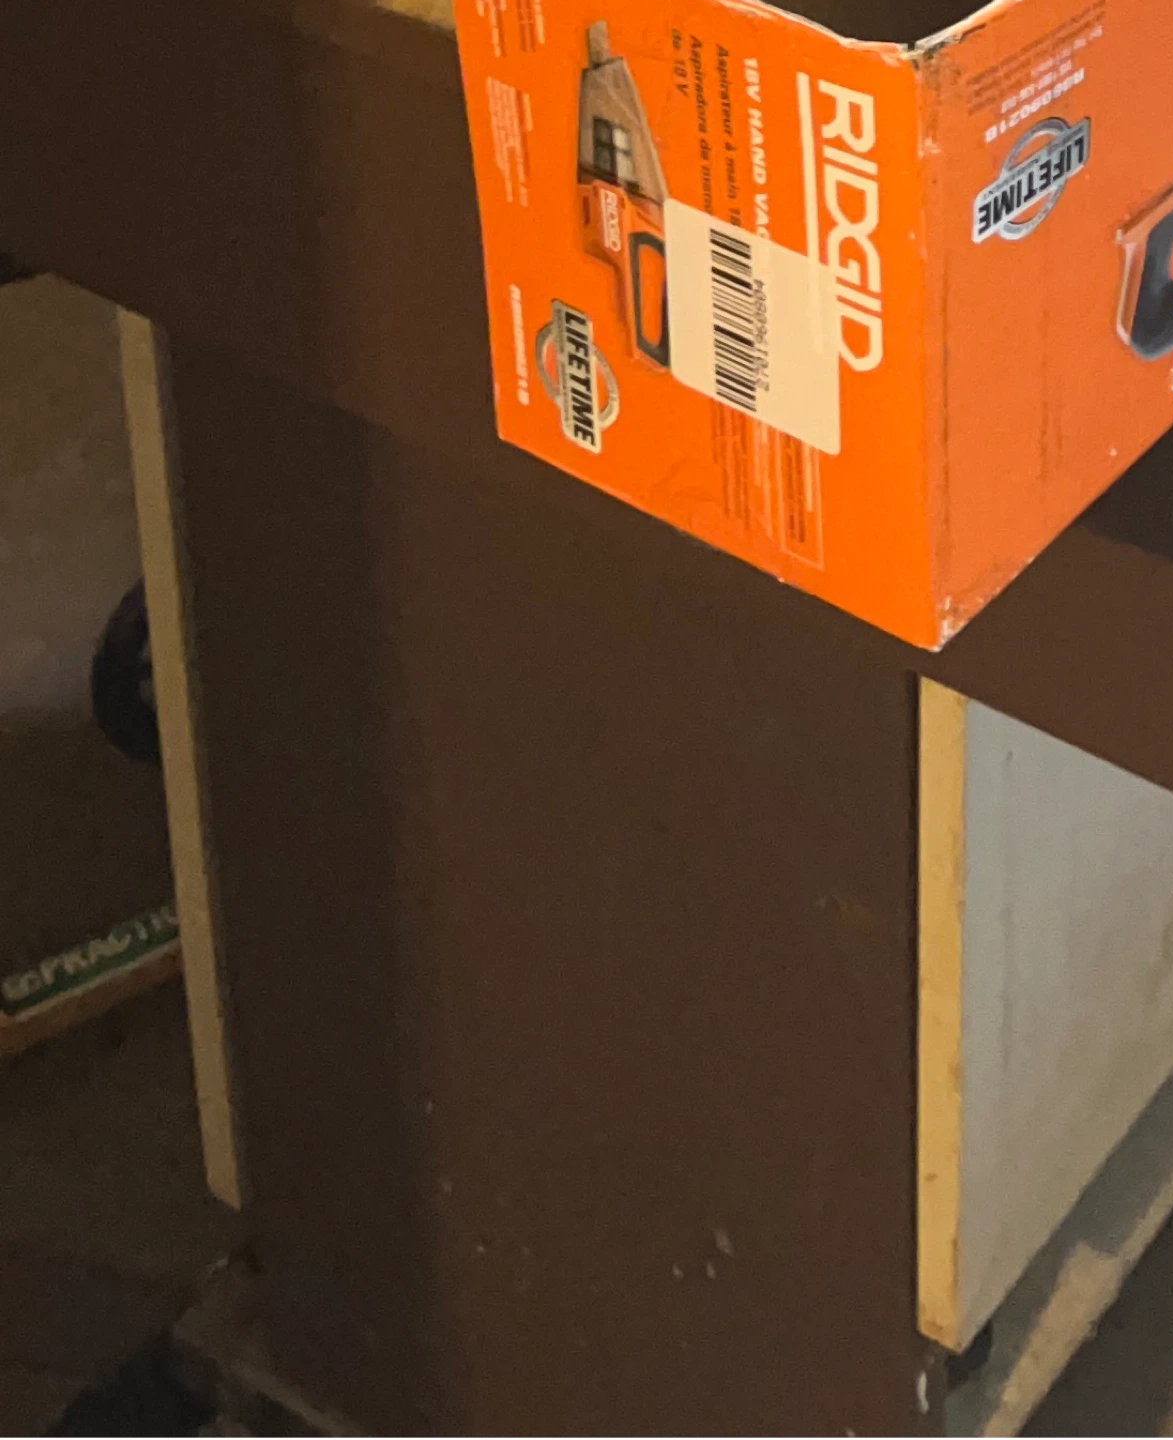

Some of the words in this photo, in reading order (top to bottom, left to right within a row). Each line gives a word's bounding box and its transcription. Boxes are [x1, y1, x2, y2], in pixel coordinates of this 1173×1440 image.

[690, 35, 708, 134] Aspiradora
[700, 138, 712, 161] de
[716, 43, 734, 138] Aspirateur
[726, 156, 740, 200] main
[743, 58, 762, 103] 18V
[747, 108, 767, 185] HAND
[977, 135, 1085, 235] LIFETIME
[602, 189, 621, 252] RIDGID
[817, 78, 884, 372] RIDGID
[565, 310, 597, 447] LIFETIME
